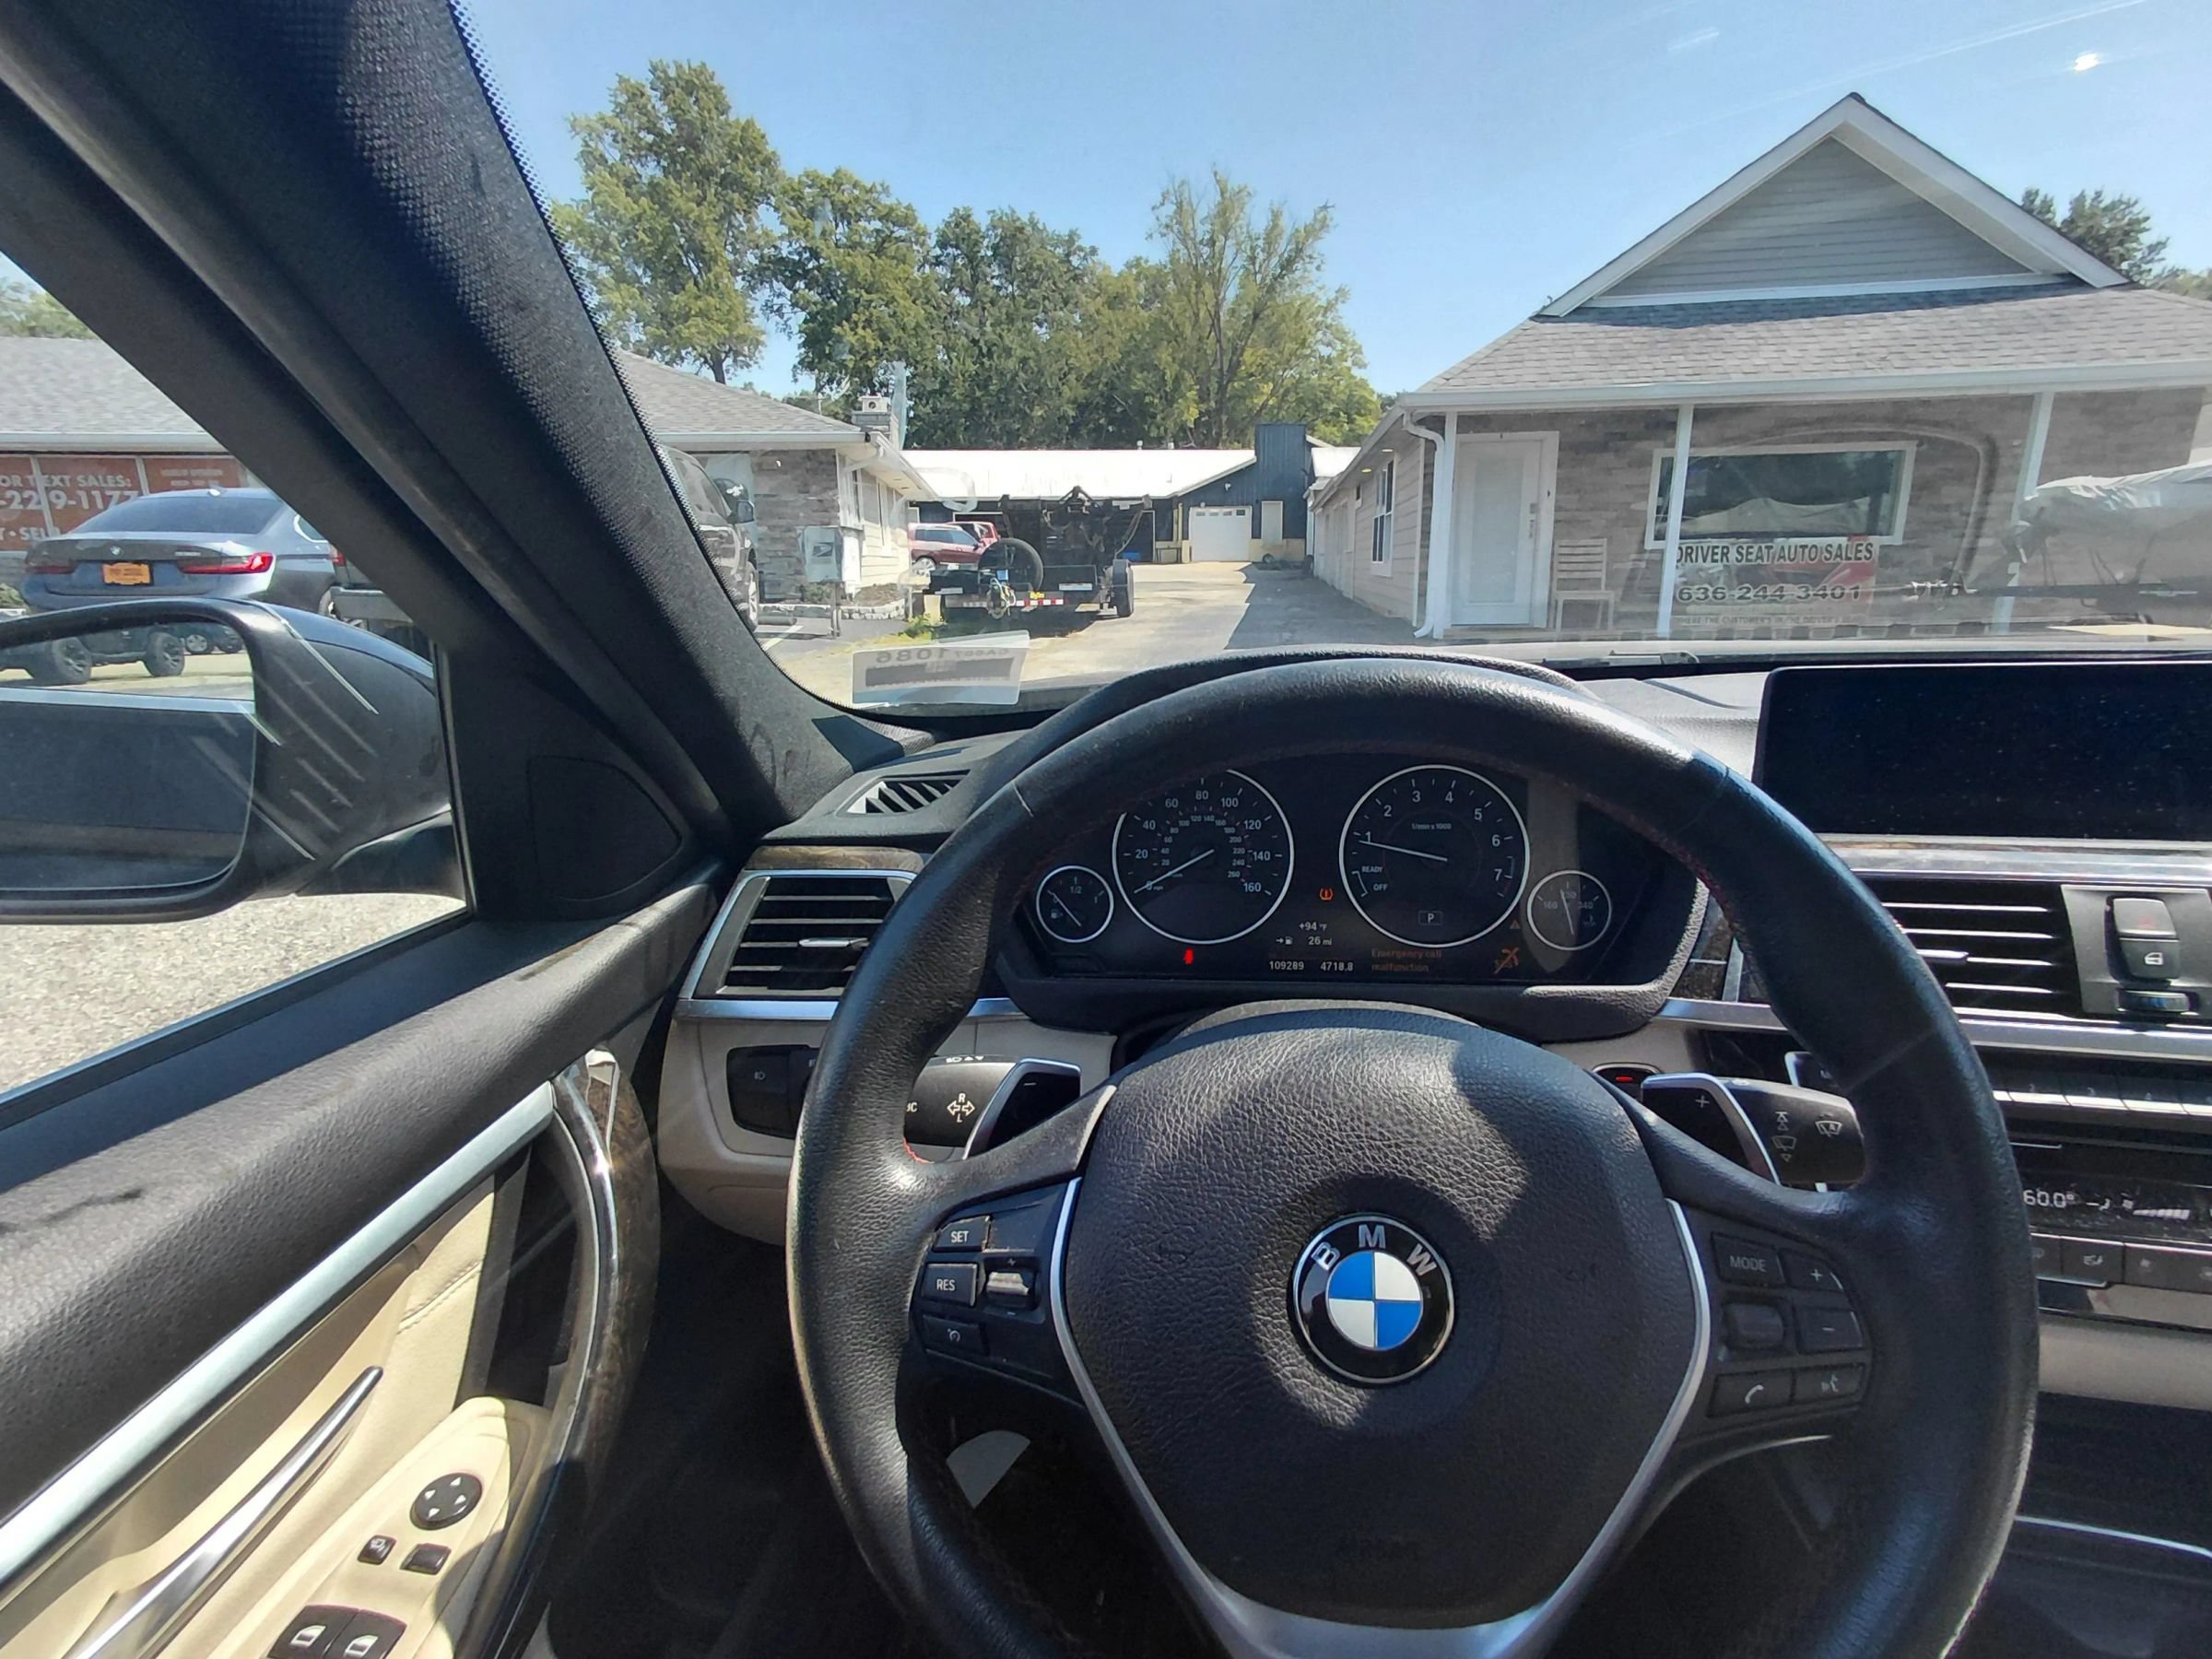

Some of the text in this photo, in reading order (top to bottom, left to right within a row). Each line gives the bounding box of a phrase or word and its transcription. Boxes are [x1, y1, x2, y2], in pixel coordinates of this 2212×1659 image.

[76, 475, 132, 488] SALES:
[1677, 542, 1874, 564] DRIVER SEAT AUTO SALES
[1677, 584, 1861, 602] 636-244-3401
[1195, 791, 1208, 800] 80
[1412, 791, 1421, 803] 3
[1444, 791, 1454, 803] 4
[1165, 799, 1178, 807] 60
[1220, 798, 1239, 807] 100
[1383, 805, 1393, 818] 2
[1474, 808, 1483, 820] 5
[1143, 820, 1156, 830] 40
[1244, 820, 1262, 830] 120
[1491, 835, 1500, 847] 6
[1135, 850, 1148, 859] 20
[1253, 852, 1270, 861] 140
[1494, 868, 1503, 881] 7
[1243, 883, 1262, 892] 160
[1428, 913, 1434, 923] P
[1308, 935, 1333, 946] 26 mi
[1371, 949, 1441, 960] Emergency call
[1269, 961, 1354, 971] 109289 4718.8
[1371, 962, 1430, 972] malfunction
[958, 1092, 966, 1103] R
[957, 1112, 963, 1124] L
[950, 1230, 969, 1243] SET
[1311, 1224, 1437, 1277] BMW
[1729, 1255, 1768, 1272] MODE
[936, 1278, 955, 1291] RES
